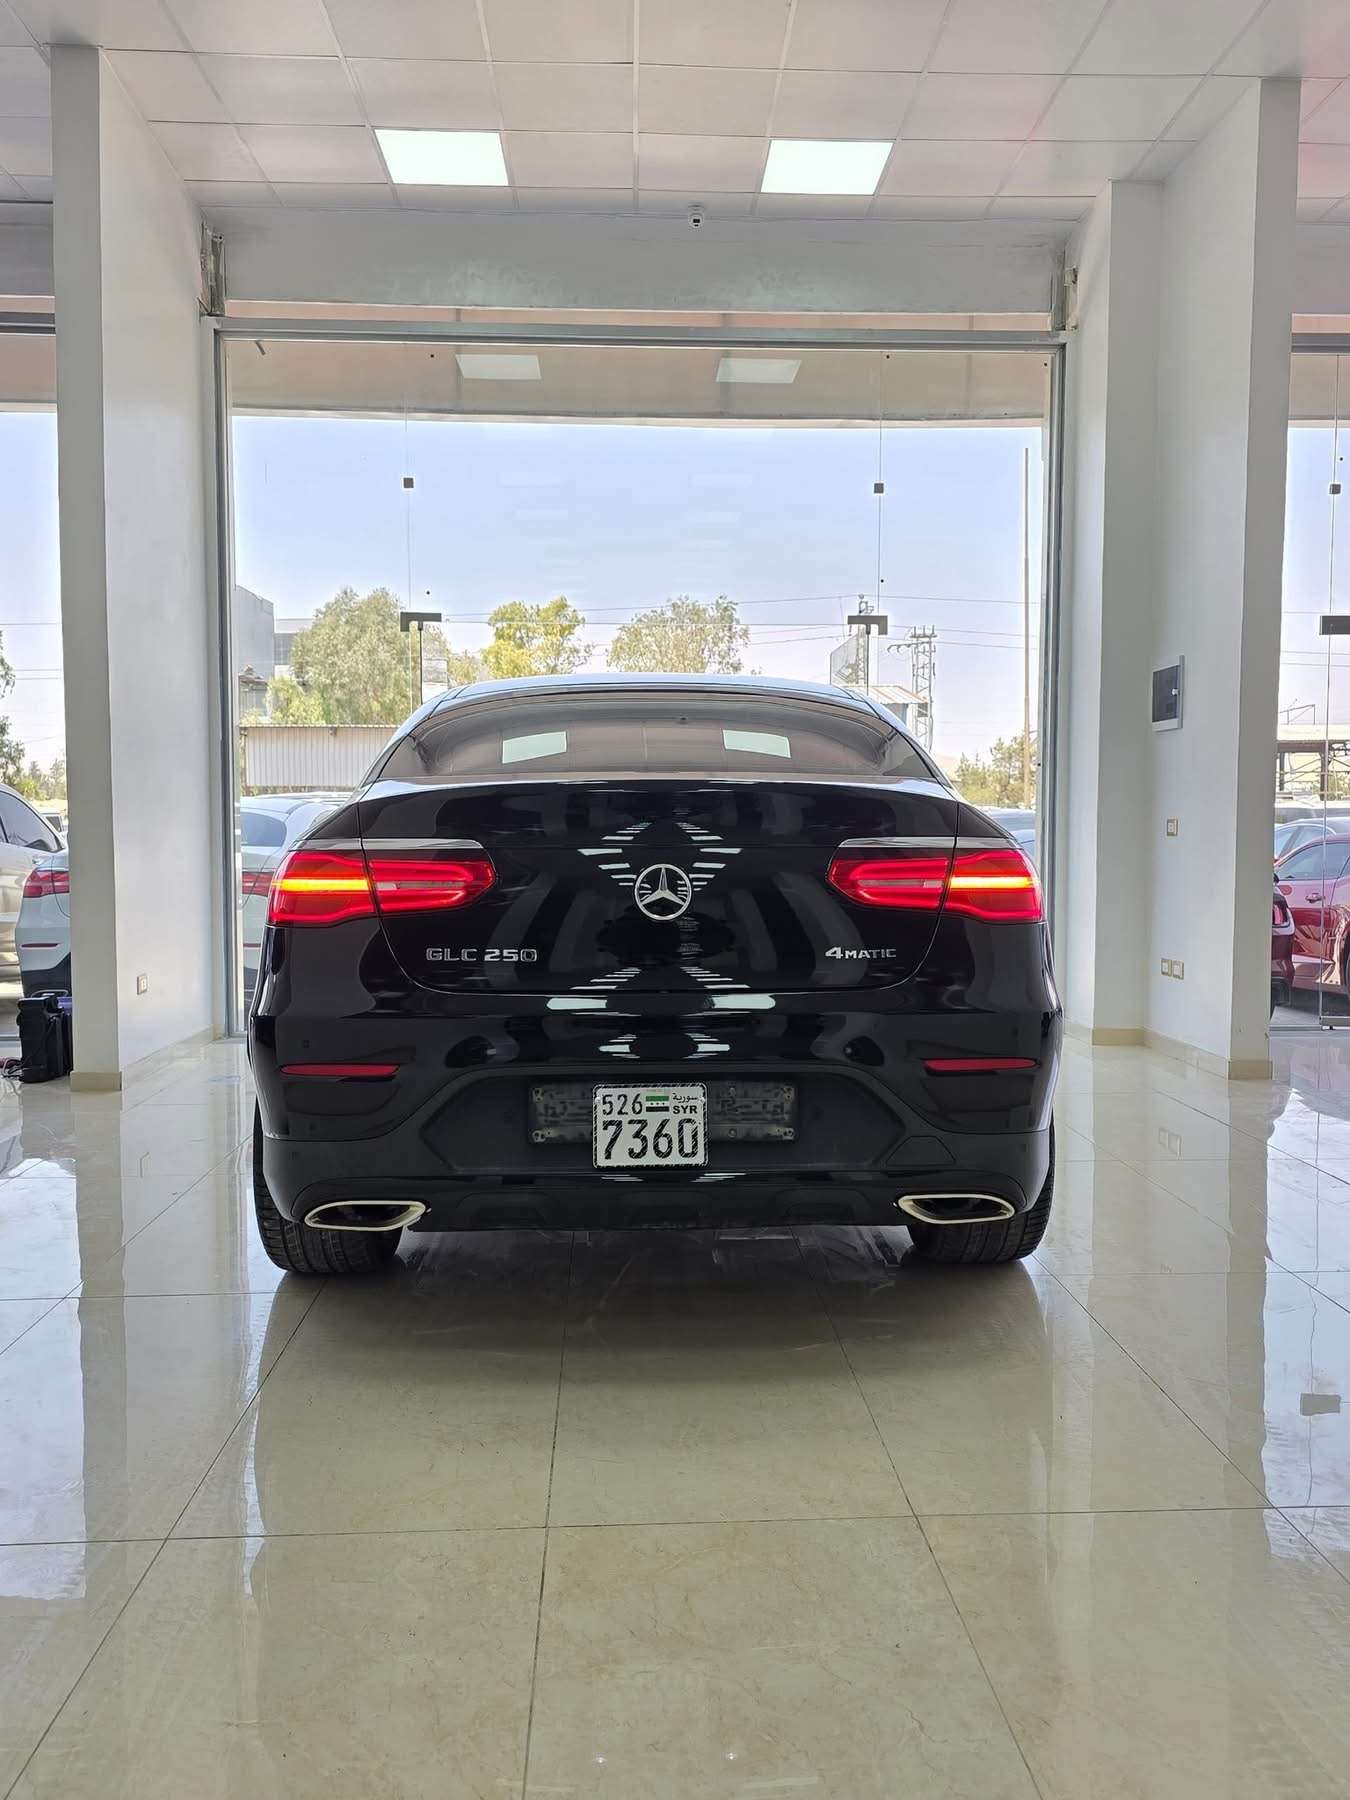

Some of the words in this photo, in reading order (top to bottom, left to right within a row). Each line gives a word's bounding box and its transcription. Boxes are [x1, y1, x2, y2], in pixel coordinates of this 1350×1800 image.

[426, 947, 478, 961] GLC
[484, 948, 538, 962] 250
[825, 946, 897, 959] 4MATIC
[602, 1093, 643, 1116] 526
[672, 1092, 698, 1104] سورية
[672, 1105, 698, 1115] SYR
[602, 1118, 699, 1160] 7360
